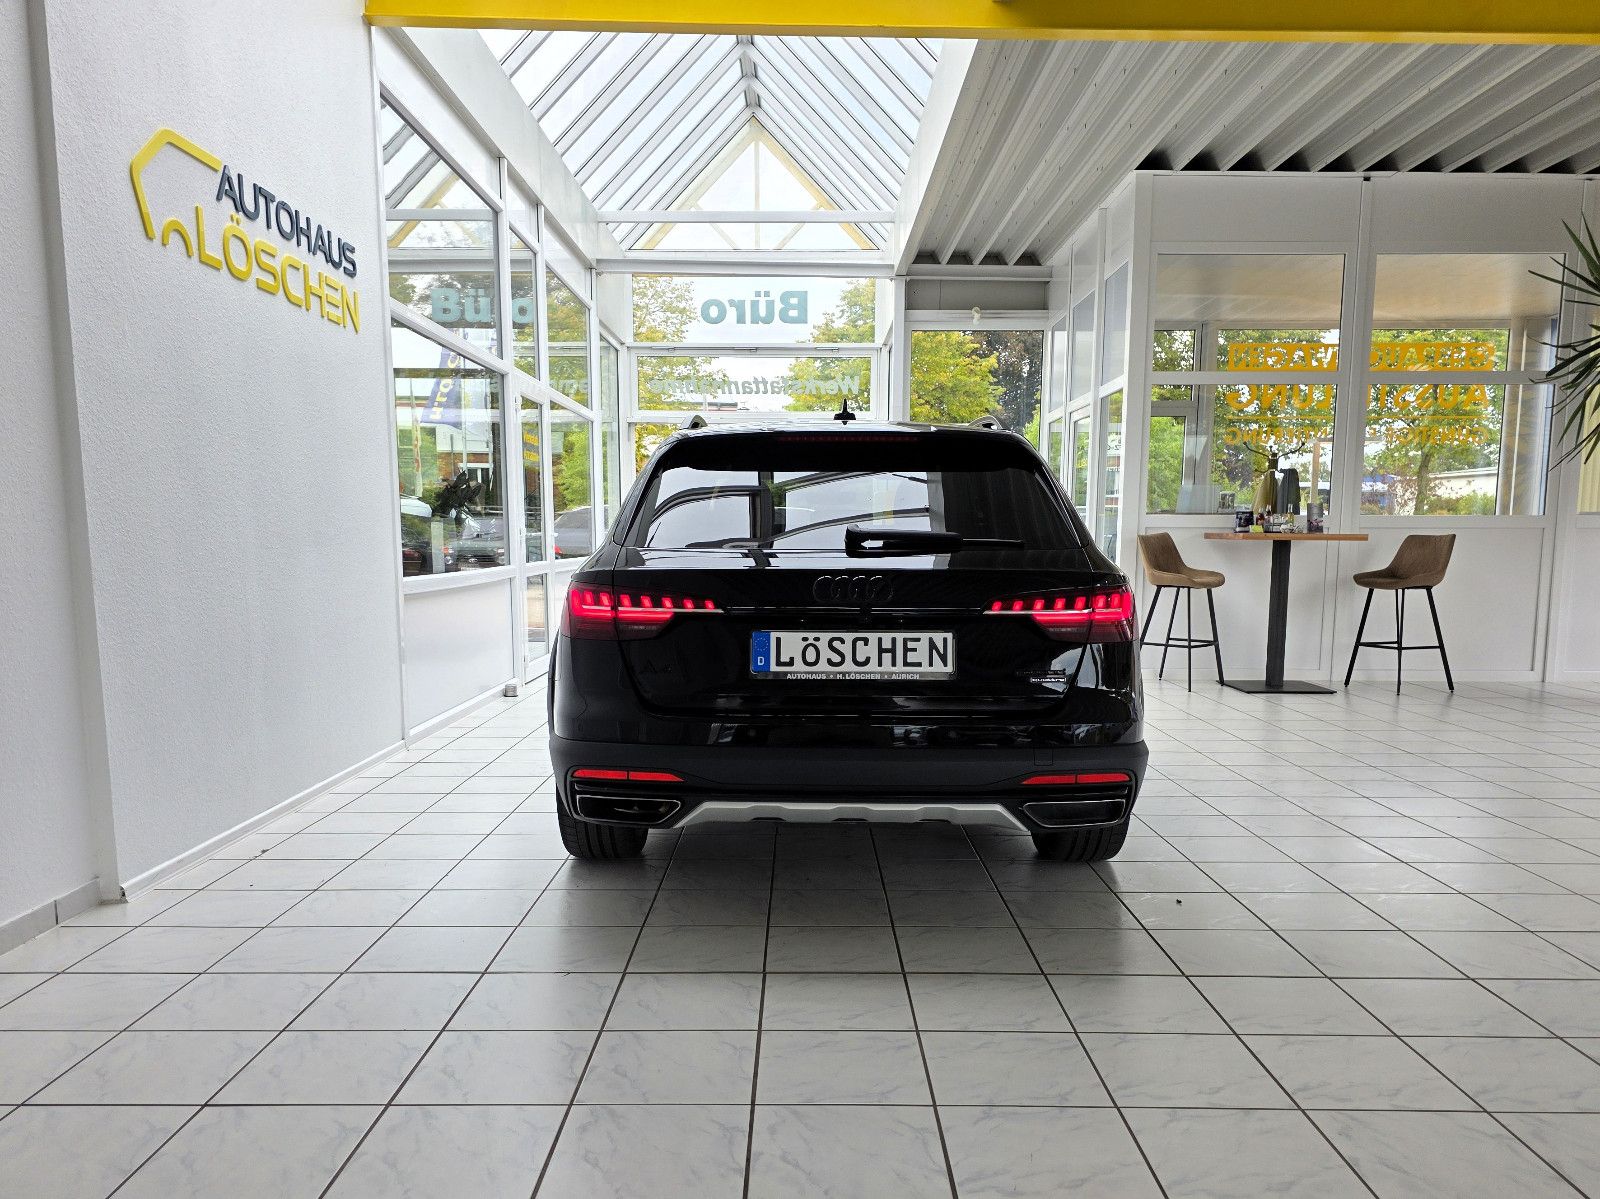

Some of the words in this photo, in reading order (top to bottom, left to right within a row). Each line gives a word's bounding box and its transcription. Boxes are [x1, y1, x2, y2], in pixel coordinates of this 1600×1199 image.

[215, 165, 358, 279] AUTOHAUS
[195, 204, 361, 335] LÖSCHEN
[431, 287, 535, 324] Büo
[757, 656, 765, 666] D
[775, 636, 948, 668] LÖSCHEN
